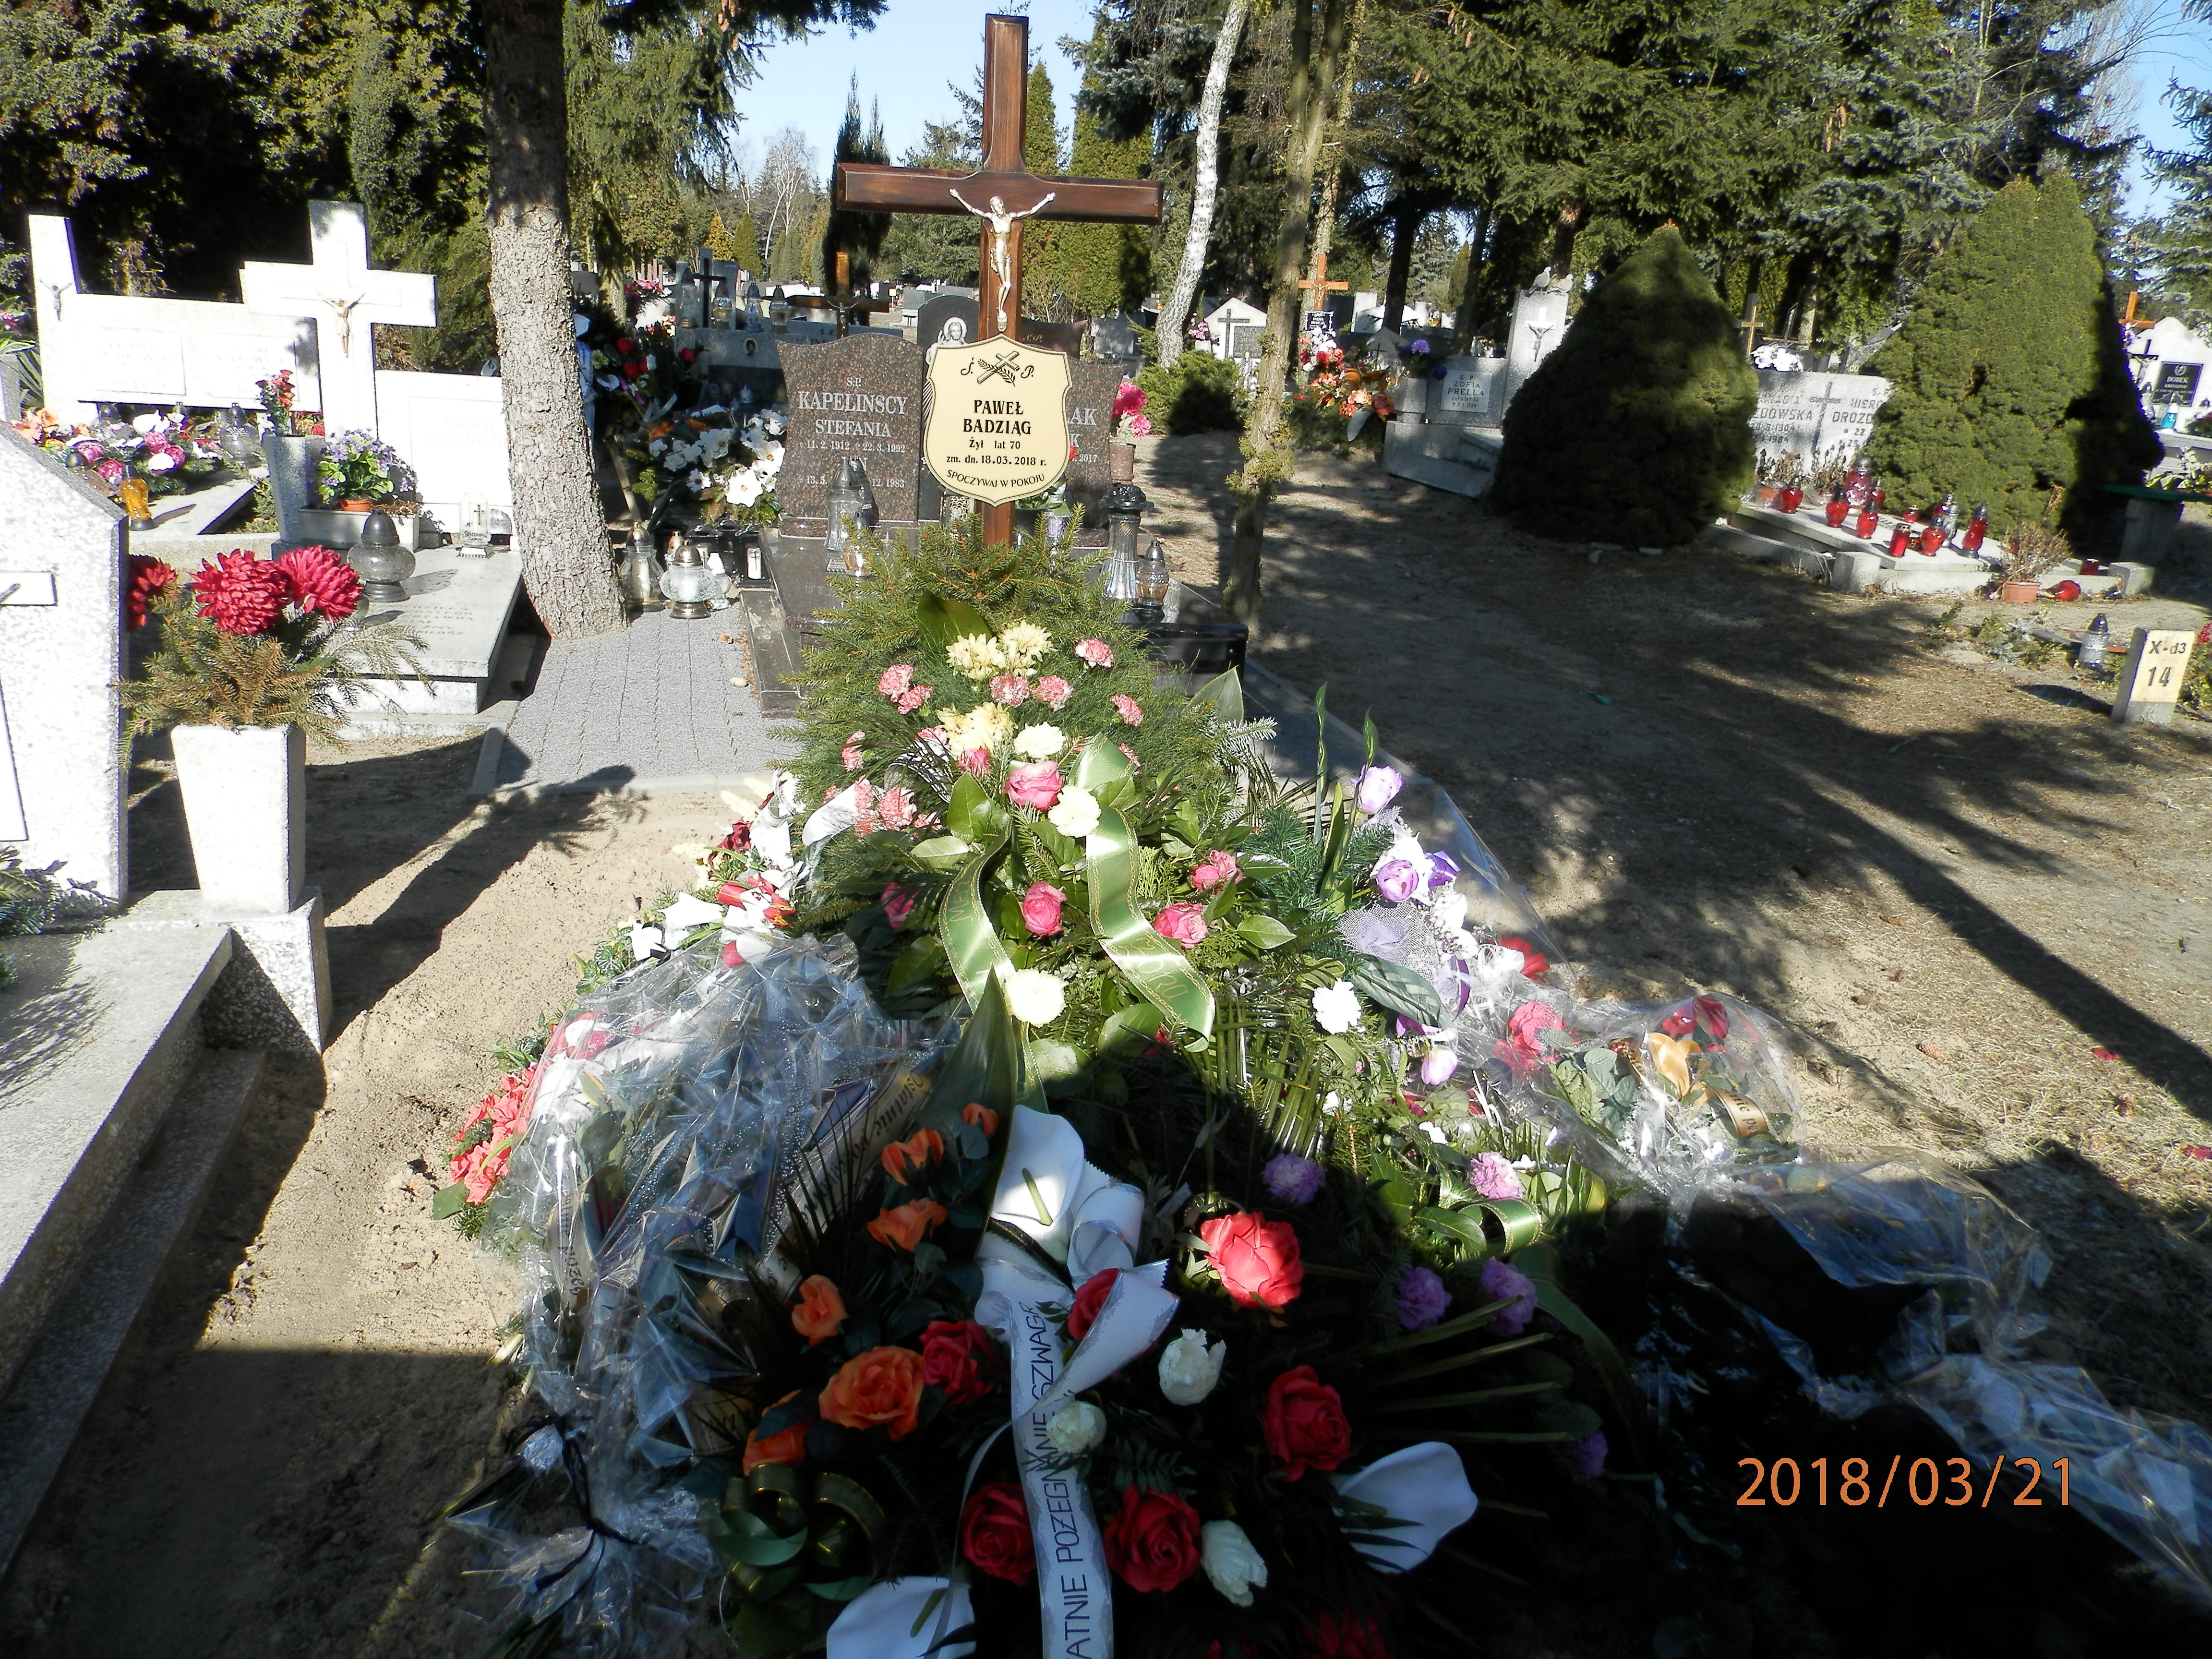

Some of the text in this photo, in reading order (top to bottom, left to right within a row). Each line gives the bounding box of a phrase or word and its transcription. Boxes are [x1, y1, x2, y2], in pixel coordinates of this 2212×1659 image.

[1448, 388, 1484, 396] PRELLA
[974, 399, 1024, 415] PAWEŁ
[815, 419, 892, 438] STEFANIA
[962, 418, 1032, 436] BADZIĄG
[969, 436, 1021, 450] Żył lat 70
[964, 455, 978, 463] dn.
[1078, 453, 1098, 463] 2017
[946, 469, 998, 488] SPOCZYWAJ
[1011, 473, 1045, 487] POKOJU
[2148, 666, 2172, 687] 14
